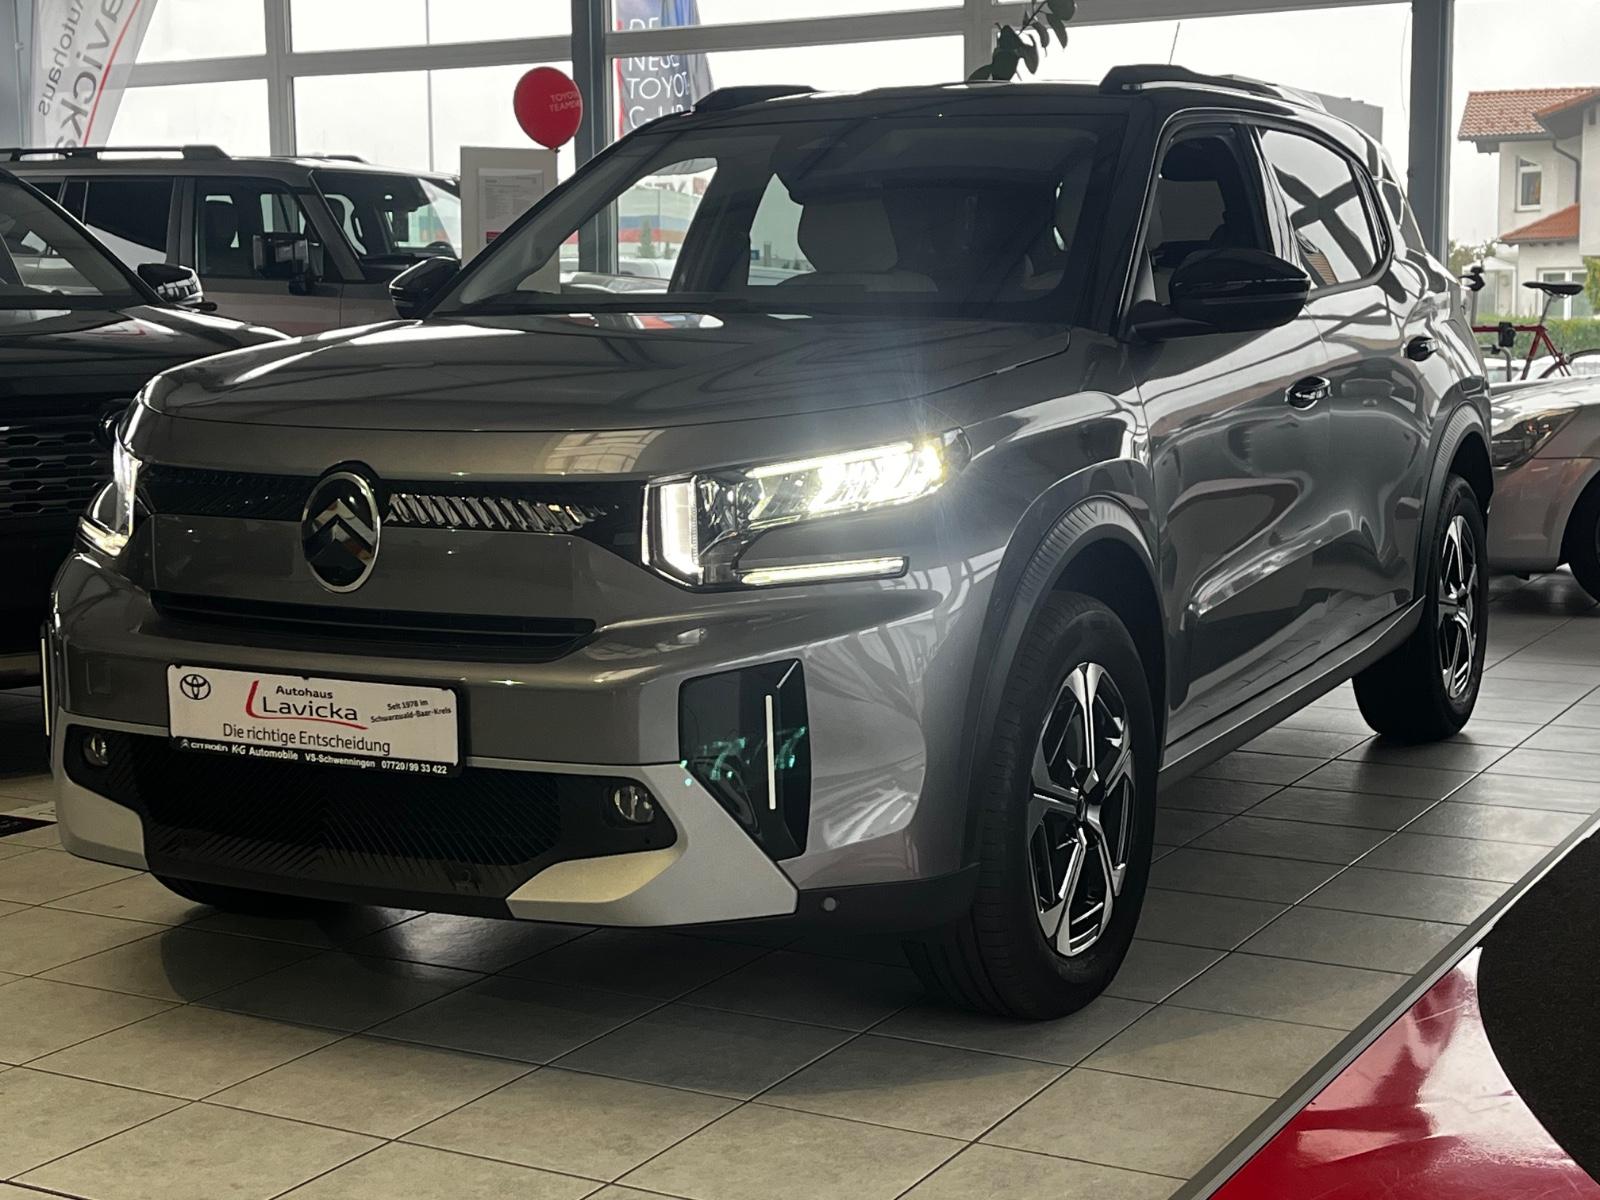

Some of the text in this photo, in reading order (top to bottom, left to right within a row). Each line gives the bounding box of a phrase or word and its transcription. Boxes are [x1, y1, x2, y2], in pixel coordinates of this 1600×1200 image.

[626, 71, 690, 99] TOYOT
[276, 685, 334, 699] Autohaus
[402, 700, 419, 709] 1978
[262, 696, 358, 721] Lavicka
[223, 722, 391, 757] Die richtige Entscheidung
[249, 746, 299, 761] Automobile
[304, 753, 376, 768] VS-Schwenningen
[420, 763, 431, 773] 33
[432, 765, 447, 775] 422
